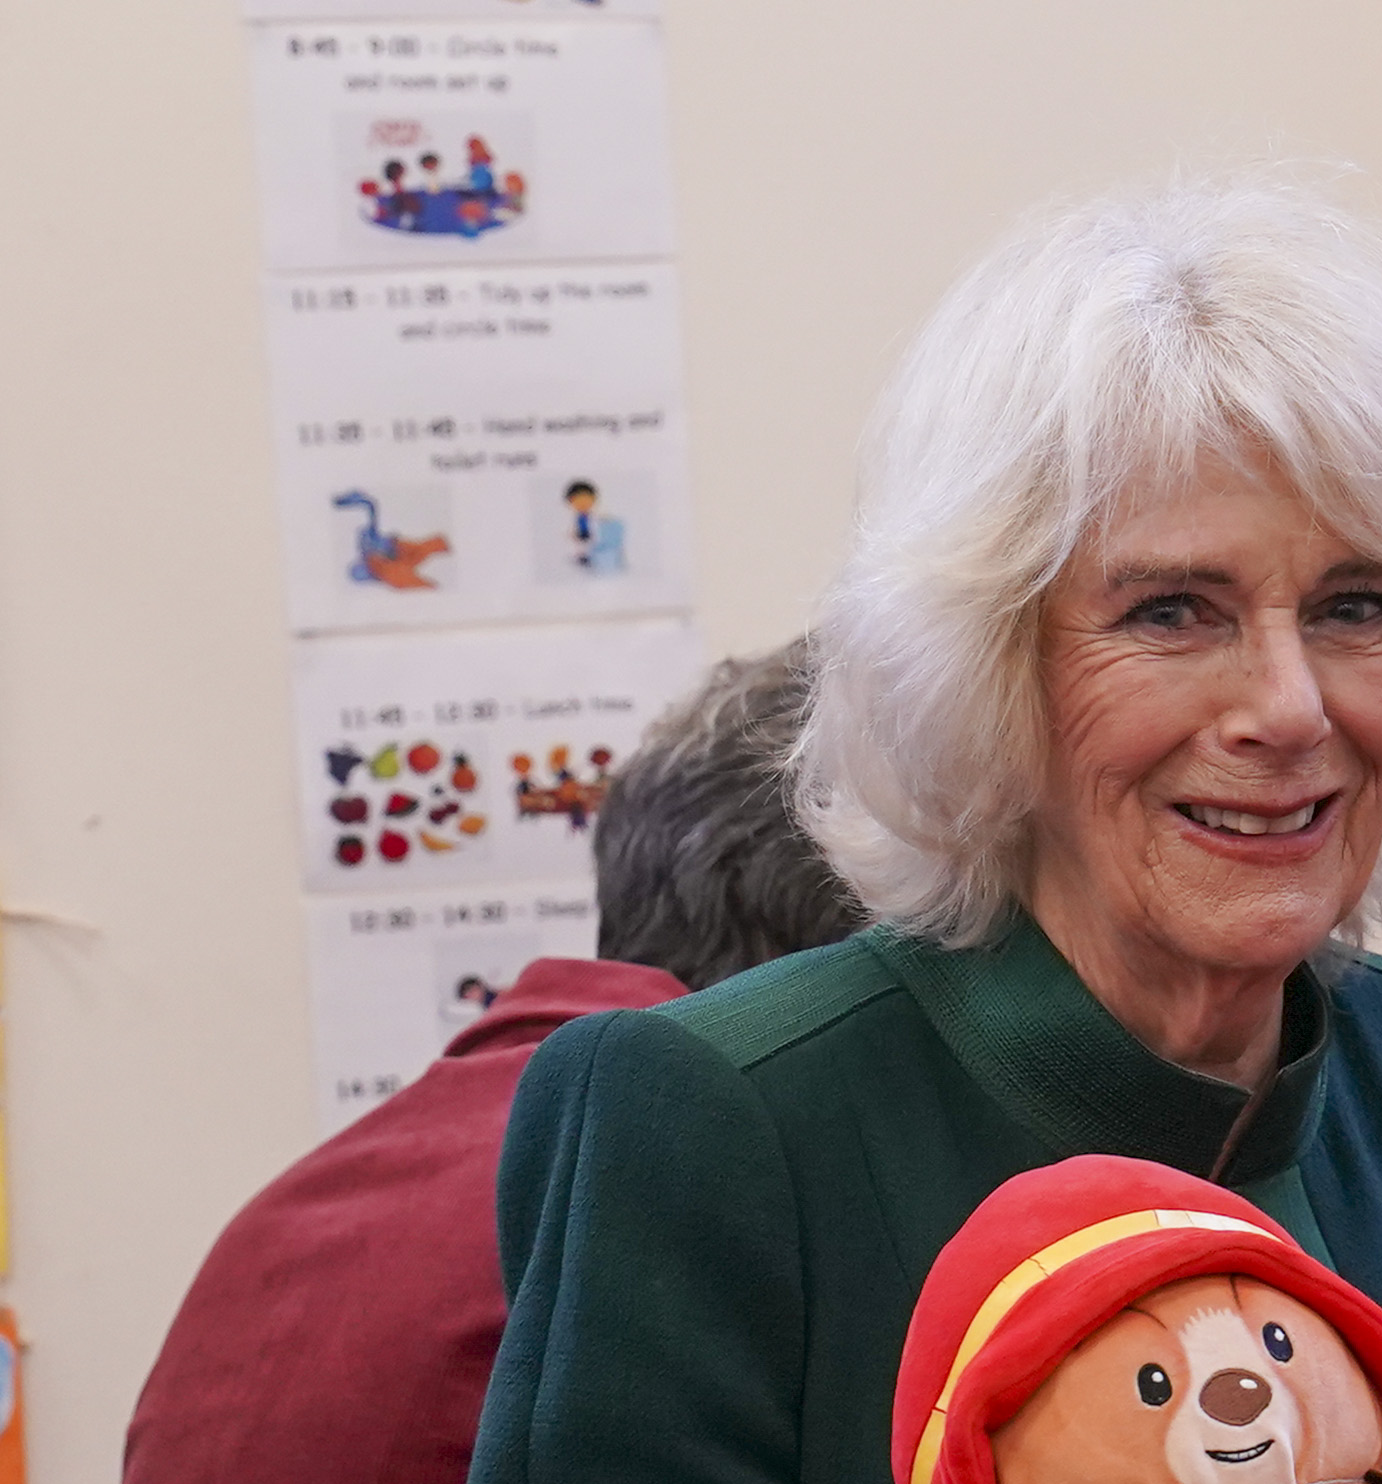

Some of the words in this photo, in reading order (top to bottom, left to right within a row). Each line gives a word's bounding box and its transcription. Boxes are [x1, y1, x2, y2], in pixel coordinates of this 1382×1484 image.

[447, 36, 506, 57] Circle
[514, 37, 559, 57] time
[345, 74, 382, 92] and
[388, 76, 439, 92] room
[479, 281, 523, 304] Tidy
[530, 285, 552, 305] up
[598, 282, 651, 299] room
[399, 322, 435, 340] and
[442, 319, 498, 338] circle
[506, 318, 552, 336] time
[482, 415, 535, 433] Hand
[543, 413, 620, 436] washing
[627, 410, 665, 429] and
[431, 452, 486, 471] toilet
[523, 697, 583, 720] Lunch
[590, 696, 634, 713] time
